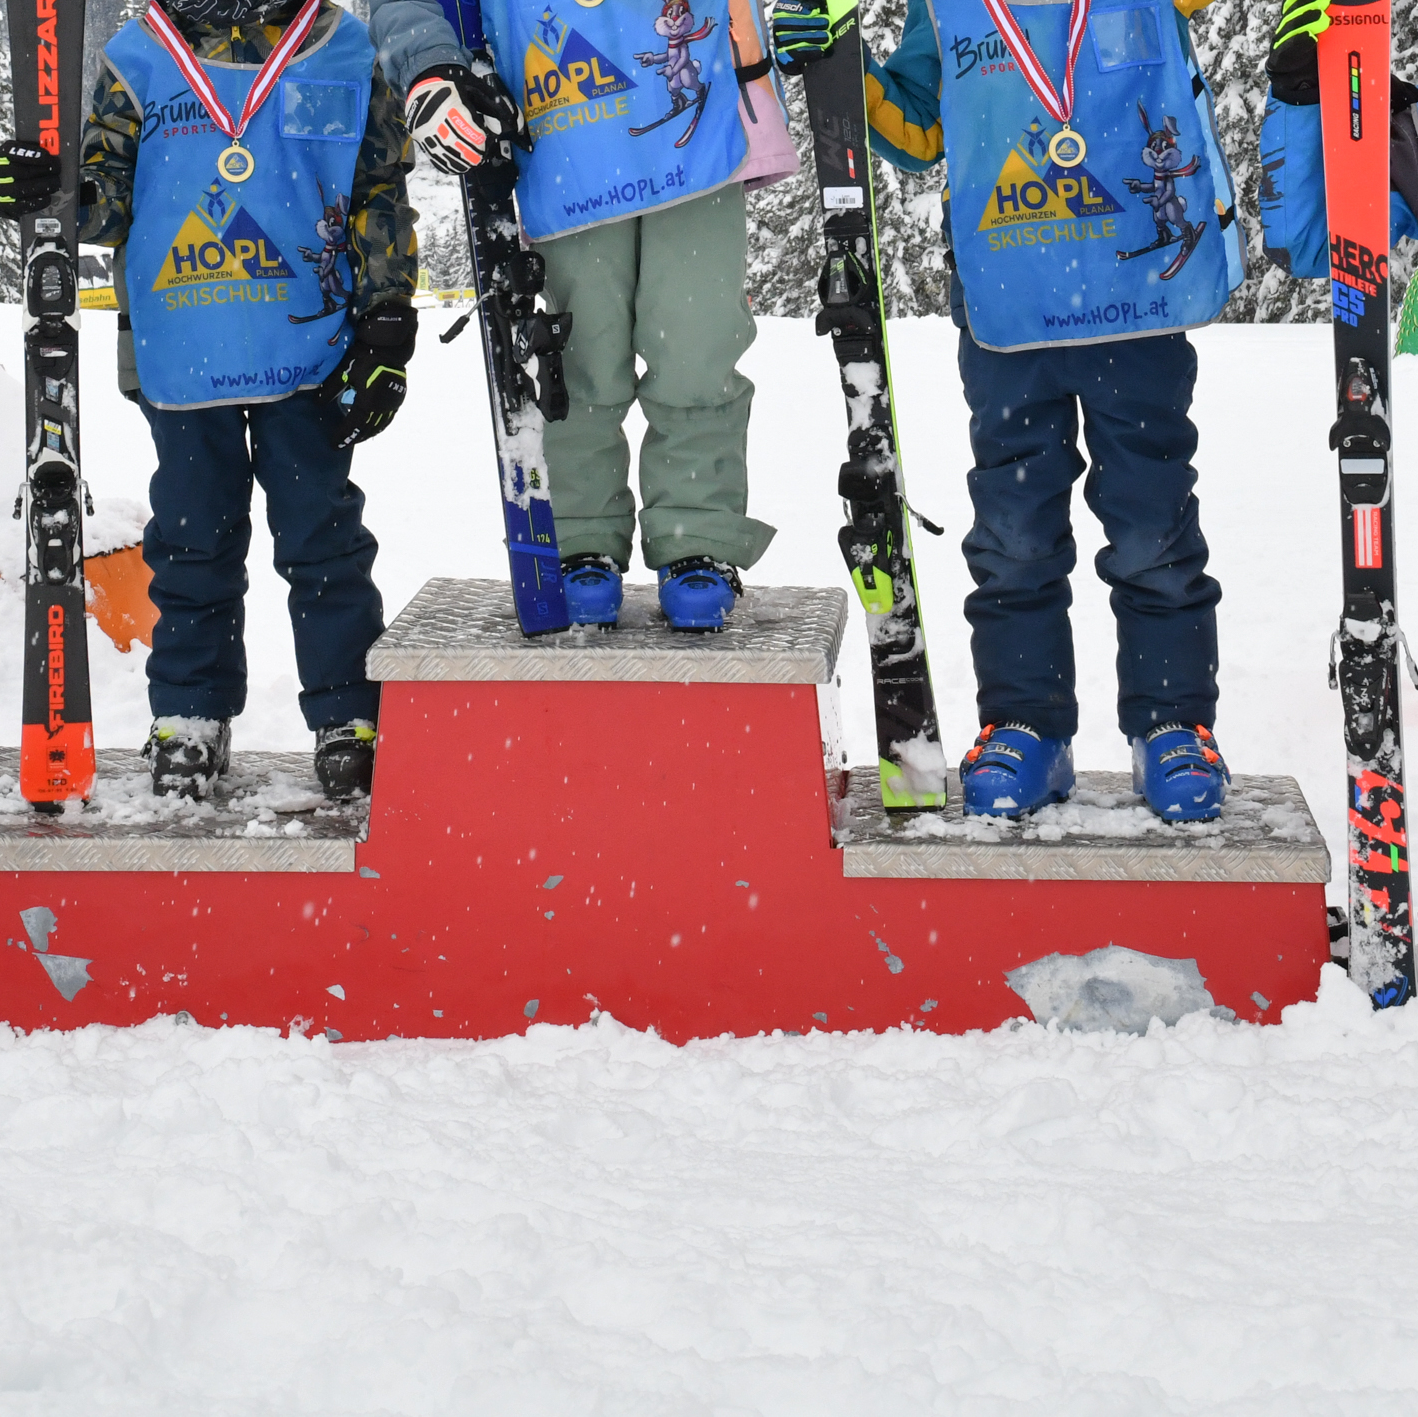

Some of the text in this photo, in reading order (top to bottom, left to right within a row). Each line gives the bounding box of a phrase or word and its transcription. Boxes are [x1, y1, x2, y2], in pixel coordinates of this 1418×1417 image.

[980, 62, 1016, 76] SPOR
[591, 81, 627, 97] PLANAI
[163, 123, 218, 139] SPORTS
[451, 114, 485, 145] reusch
[1353, 111, 1361, 139] RACING
[562, 164, 686, 217] www.HOPL.at
[995, 176, 1104, 214] HOPL
[990, 210, 1057, 226] HOCHWURZEN
[1079, 204, 1115, 215] PLANAI
[987, 218, 1118, 252] SKISCHULE
[171, 238, 280, 275] HOPL
[167, 270, 233, 286] HOCHWURZEN
[256, 269, 289, 278] PLANAI
[1331, 266, 1378, 298] ATHLETE
[165, 283, 289, 311] SKISCHULE
[1332, 279, 1365, 317] GS
[1043, 295, 1169, 328] www.HOPL.at
[1333, 305, 1359, 328] PRO
[47, 603, 66, 733] FIREBIRD
